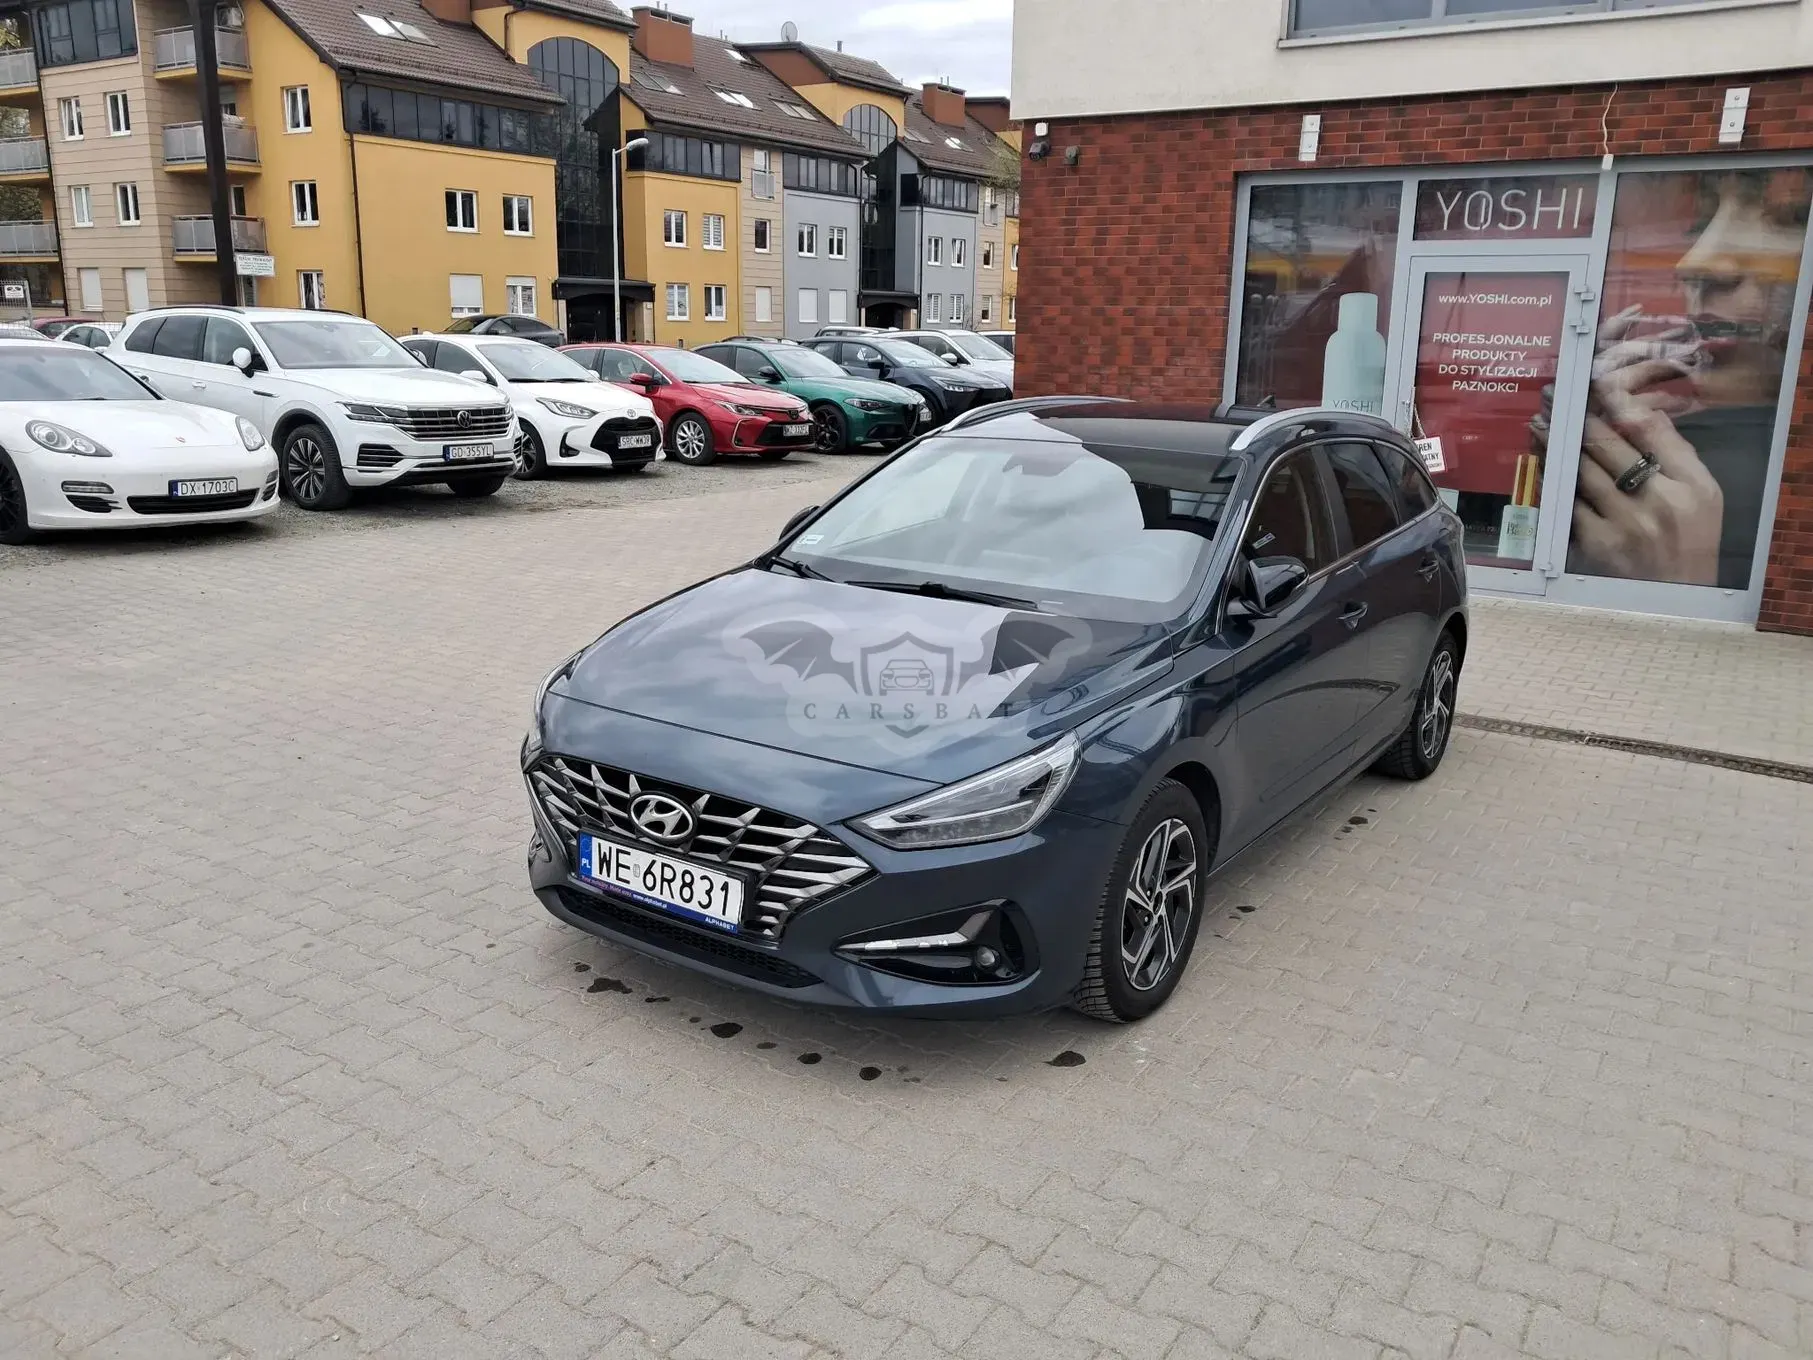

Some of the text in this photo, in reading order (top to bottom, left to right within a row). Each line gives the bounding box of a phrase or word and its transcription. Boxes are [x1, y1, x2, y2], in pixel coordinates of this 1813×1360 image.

[1436, 187, 1583, 230] YOSHI
[1438, 293, 1552, 307] www.YOSHI.com.pl
[1432, 332, 1552, 346] PROFESJONALNE
[1452, 349, 1527, 361] PRODUKTY
[1438, 364, 1538, 378] DO STYLIZACJI
[1452, 380, 1519, 393] PAZNOKCI
[451, 447, 463, 458] GD
[180, 480, 235, 496] DX 1703C
[581, 857, 591, 868] PL
[597, 842, 730, 916] WE 6R831
[704, 916, 735, 932] ALPHABET
